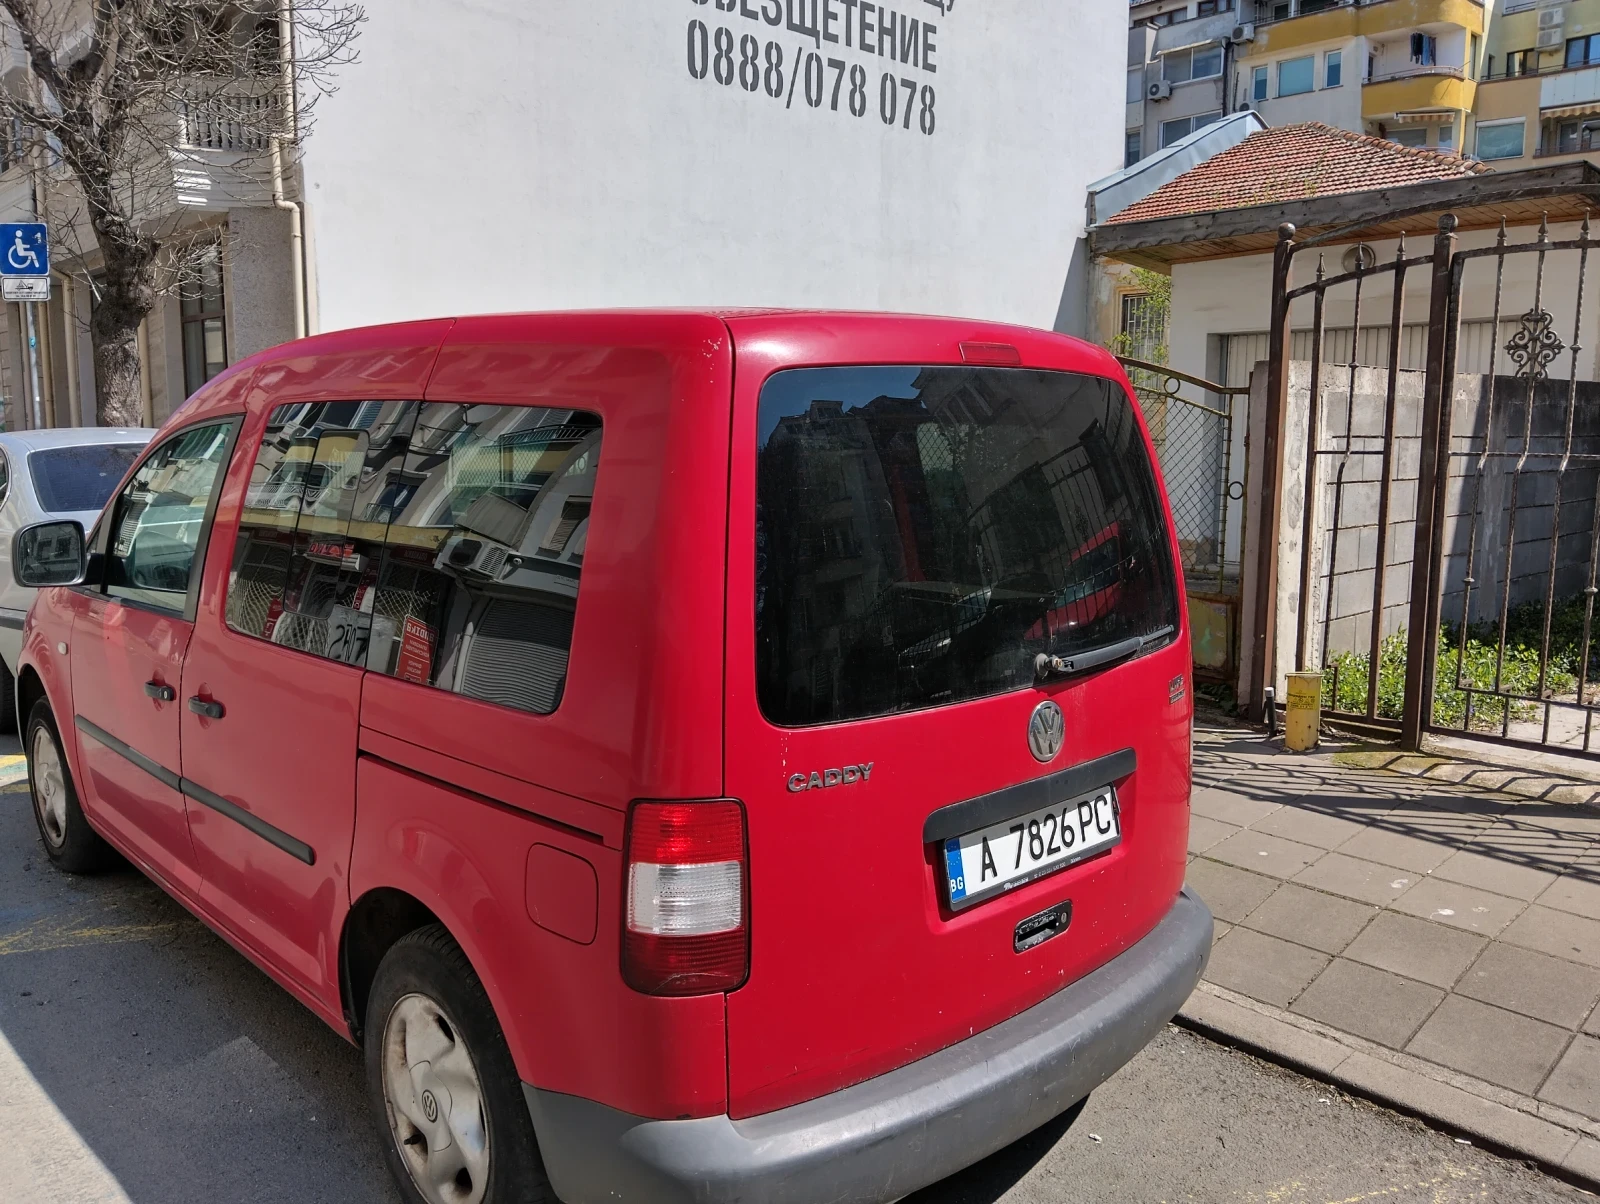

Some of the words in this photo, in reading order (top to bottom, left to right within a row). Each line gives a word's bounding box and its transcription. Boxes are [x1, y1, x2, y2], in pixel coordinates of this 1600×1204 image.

[692, 0, 937, 73] ЩЕТЕНИЕ
[687, 19, 867, 117] 0888/078
[879, 72, 936, 136] 078
[787, 762, 875, 793] CADDY
[980, 836, 998, 882] A
[950, 877, 964, 893] BG
